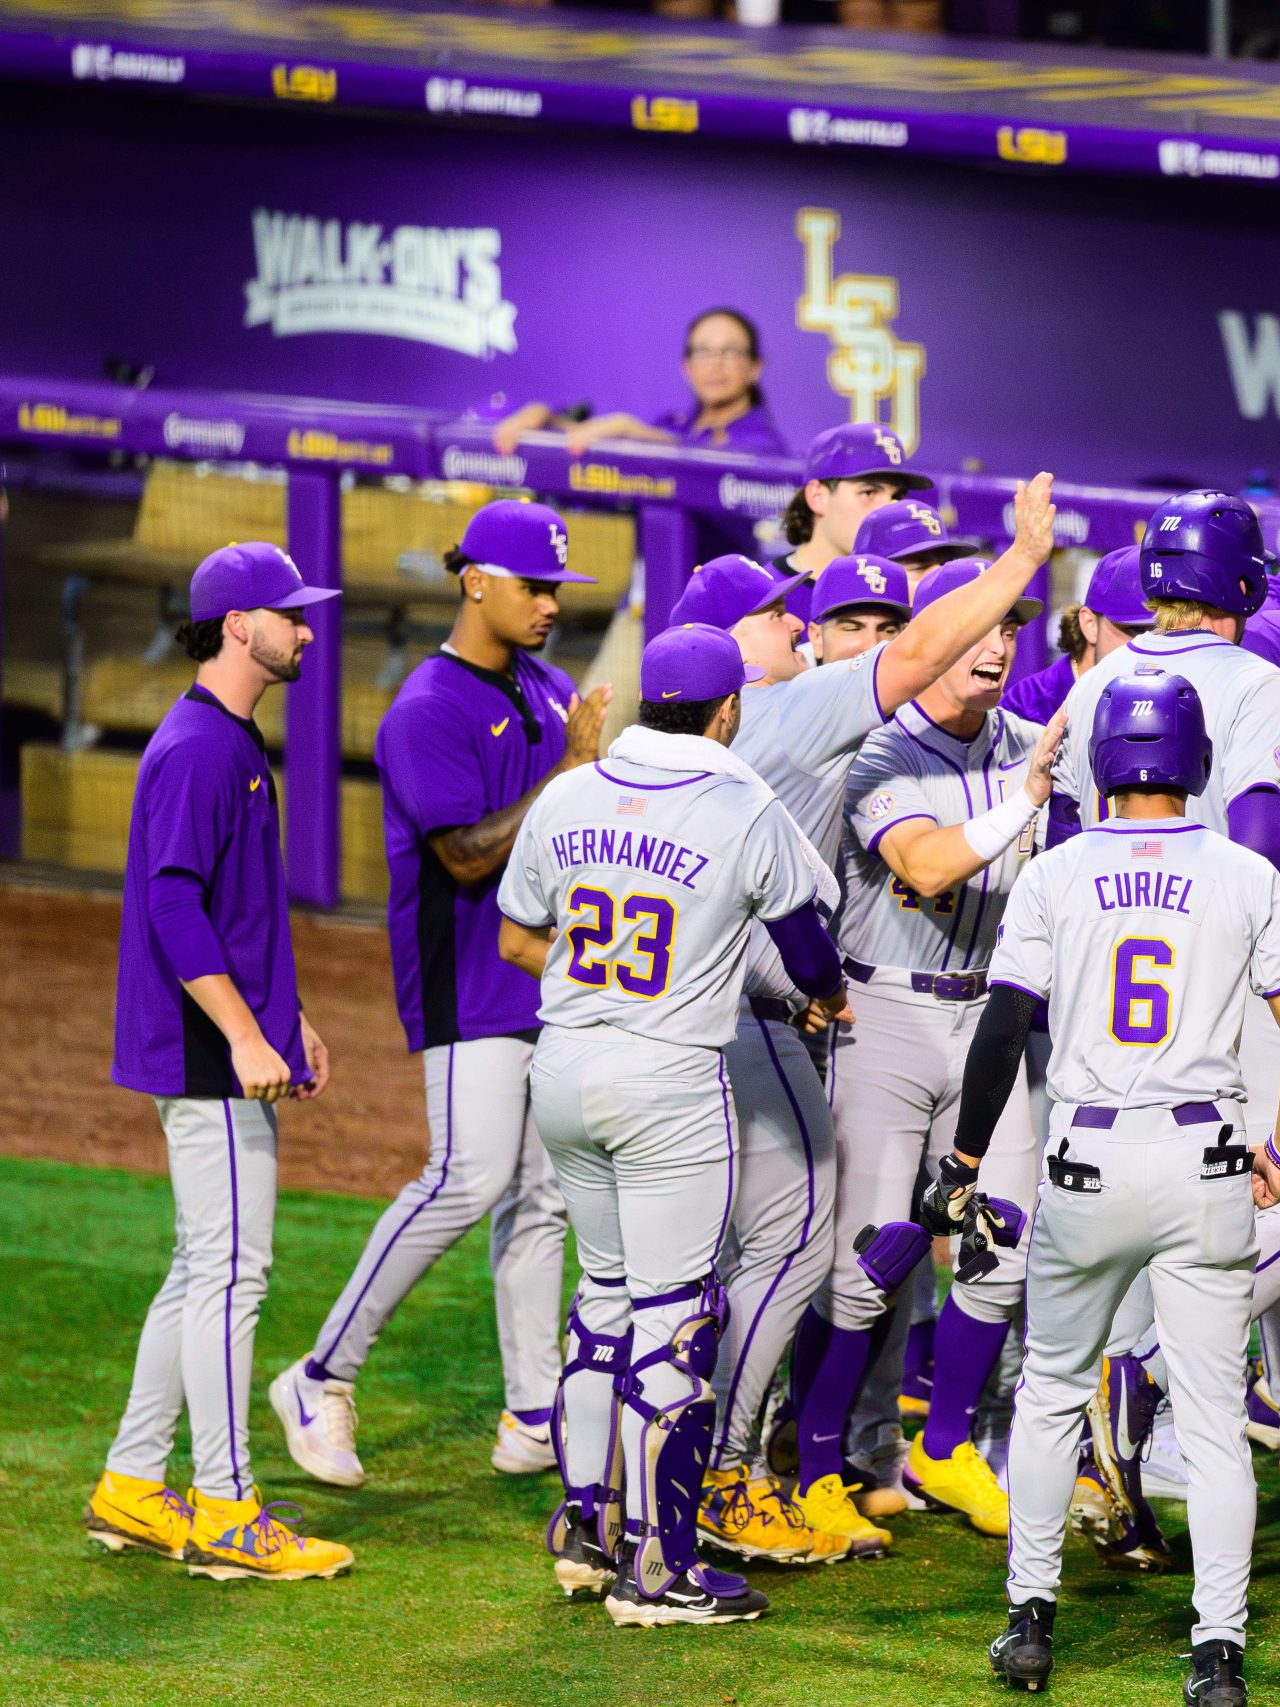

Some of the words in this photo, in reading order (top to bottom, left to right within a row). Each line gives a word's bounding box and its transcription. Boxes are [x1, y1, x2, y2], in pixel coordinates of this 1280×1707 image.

[272, 64, 337, 102] LSU
[631, 96, 699, 133] LSU
[998, 127, 1067, 165] LSU
[872, 428, 902, 466] LSU
[906, 503, 942, 537] LSU
[856, 557, 888, 595] LSU
[1149, 562, 1163, 579] 16
[1139, 769, 1148, 782] 6
[551, 829, 710, 890] HERNANDEZ
[1093, 870, 1193, 914] CURIEL
[565, 883, 679, 1001] 23
[1108, 934, 1176, 1048] 6
